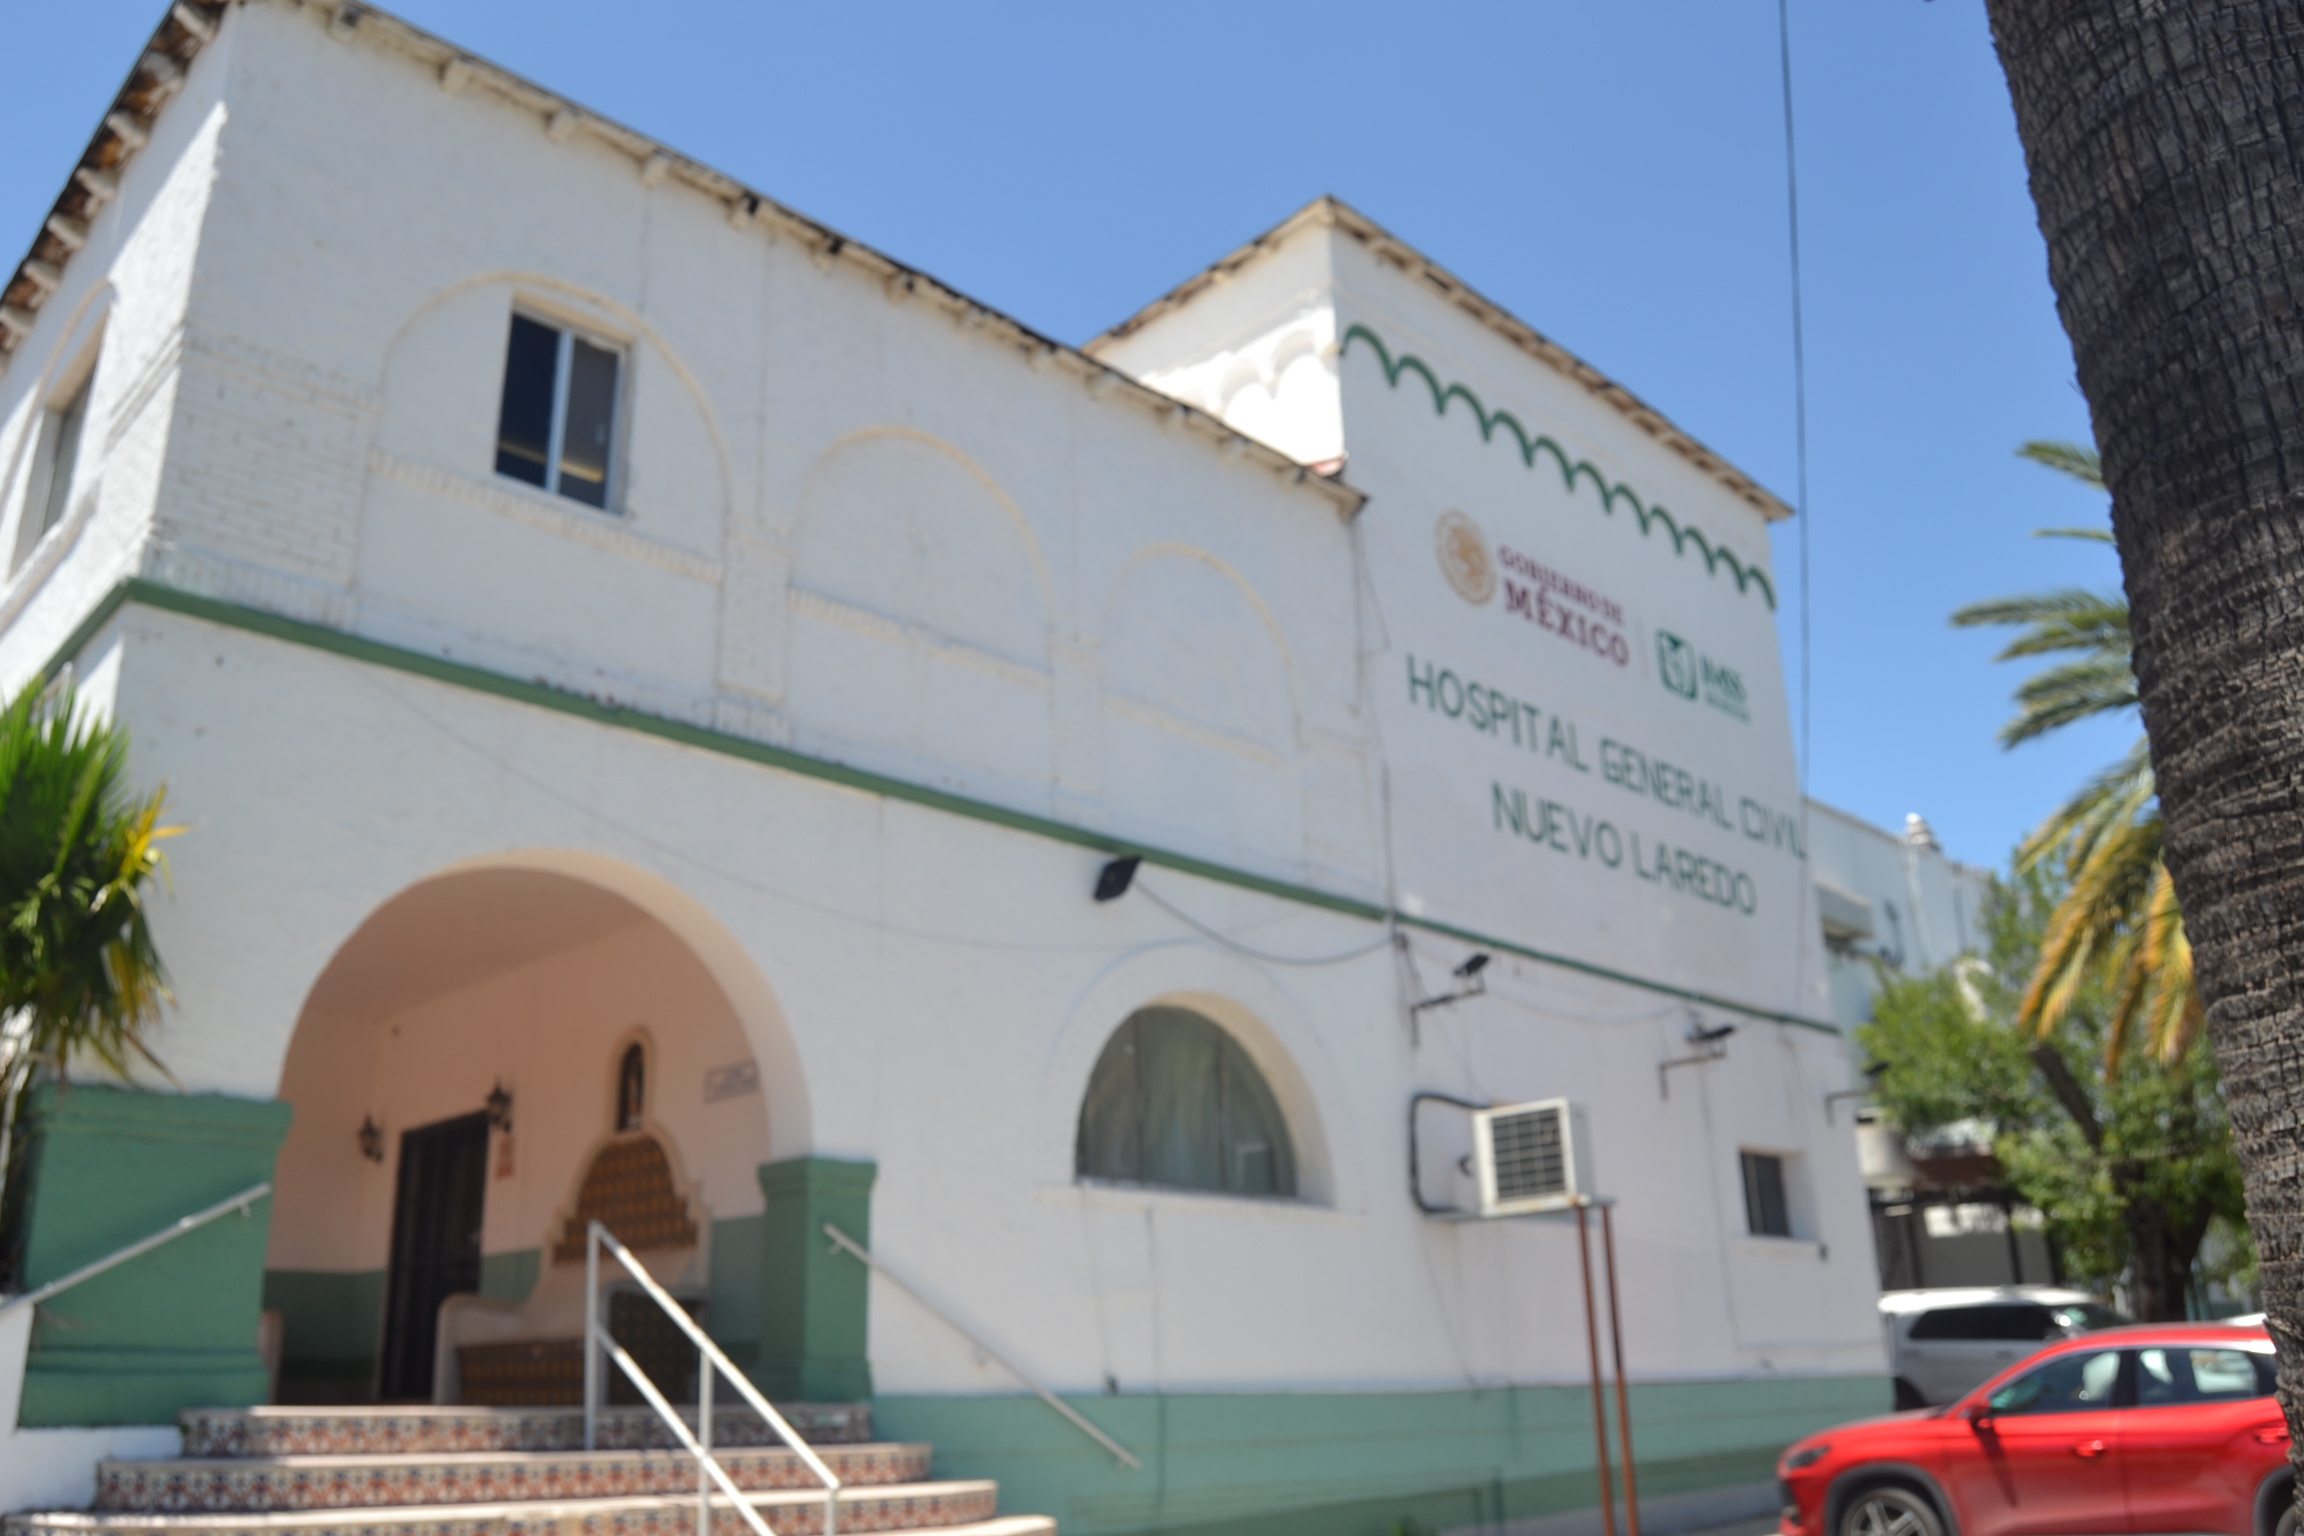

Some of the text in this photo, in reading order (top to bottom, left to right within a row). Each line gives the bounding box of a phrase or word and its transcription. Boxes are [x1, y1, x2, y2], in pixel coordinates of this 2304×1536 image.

[1498, 546, 1625, 627] GOBIERNO DE
[1504, 578, 1628, 667] MÉXICO
[1406, 654, 1807, 860] HOSPITAL GENERAL CIVIL
[1492, 781, 1757, 916] NUEVO LAREDO
